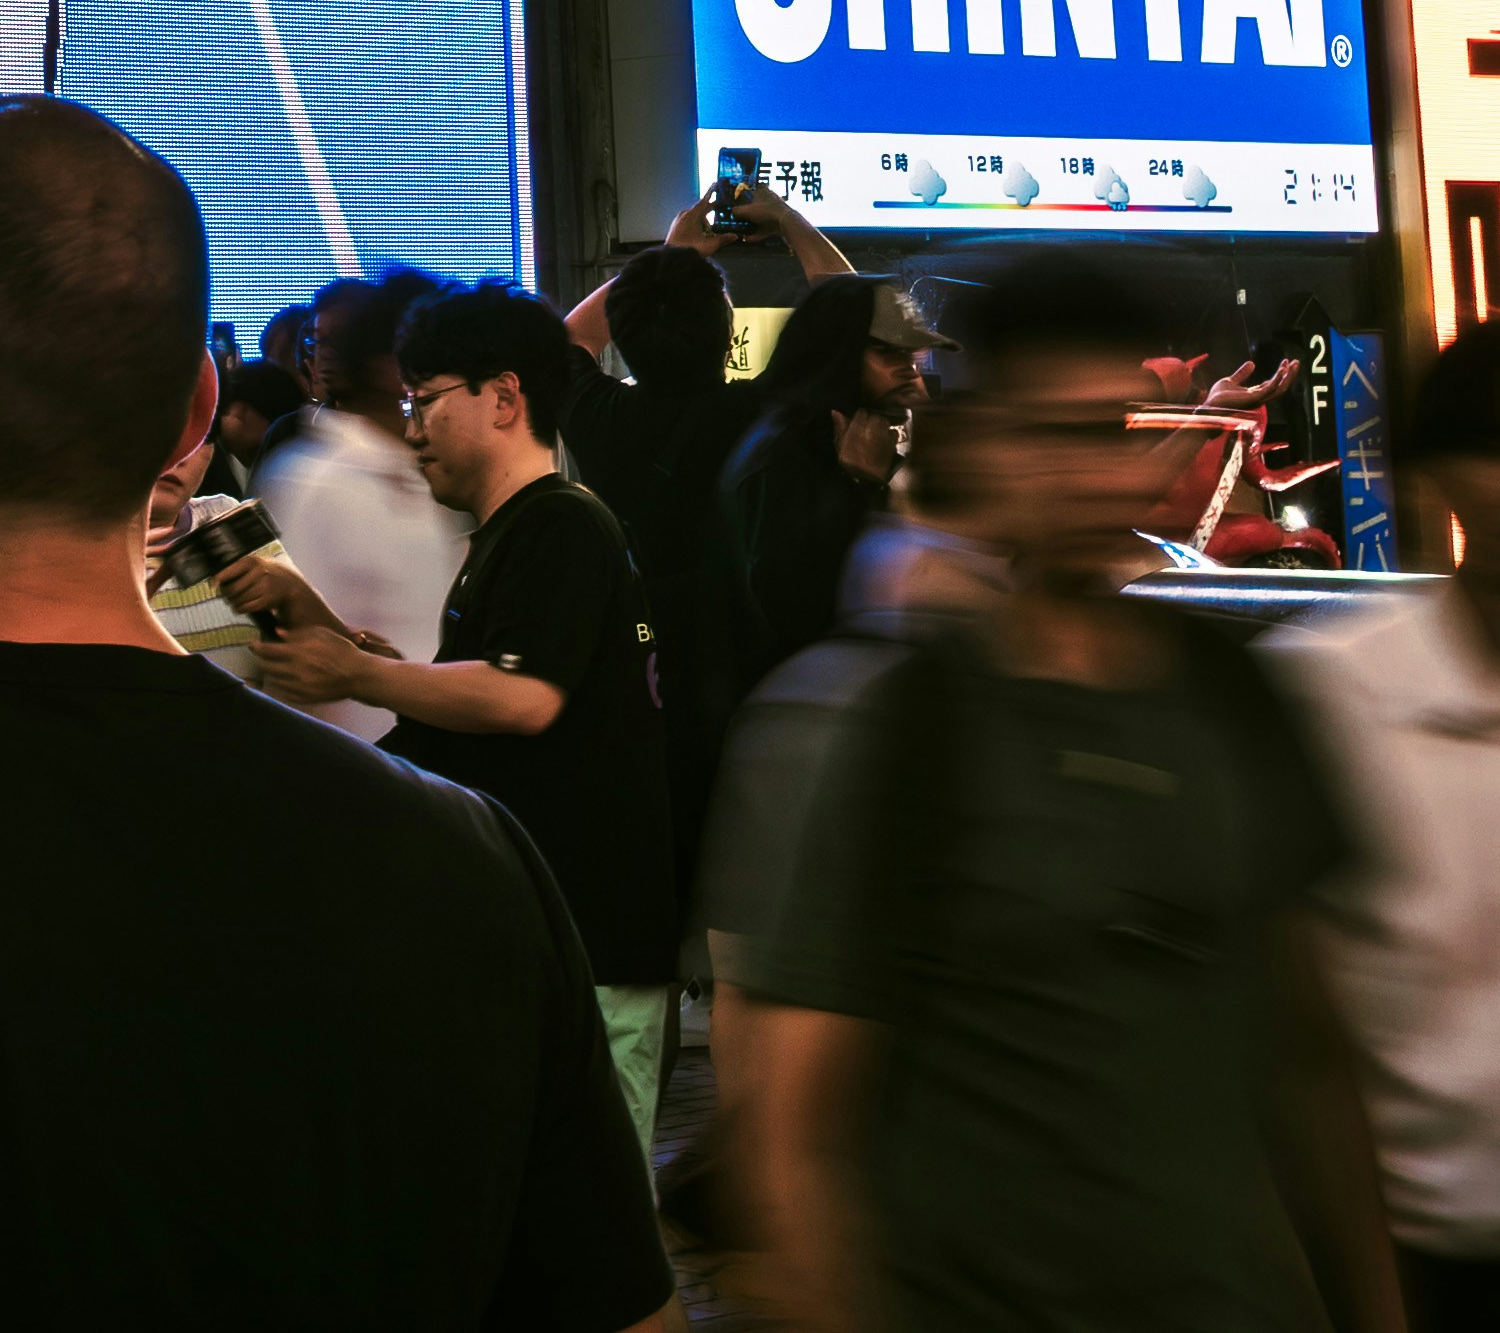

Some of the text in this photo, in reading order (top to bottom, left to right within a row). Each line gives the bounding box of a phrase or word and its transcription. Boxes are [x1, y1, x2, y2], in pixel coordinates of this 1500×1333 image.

[880, 152, 909, 174] 6時
[966, 154, 1004, 176] 12時
[1058, 156, 1096, 177] 18時
[1147, 158, 1185, 179] 24時
